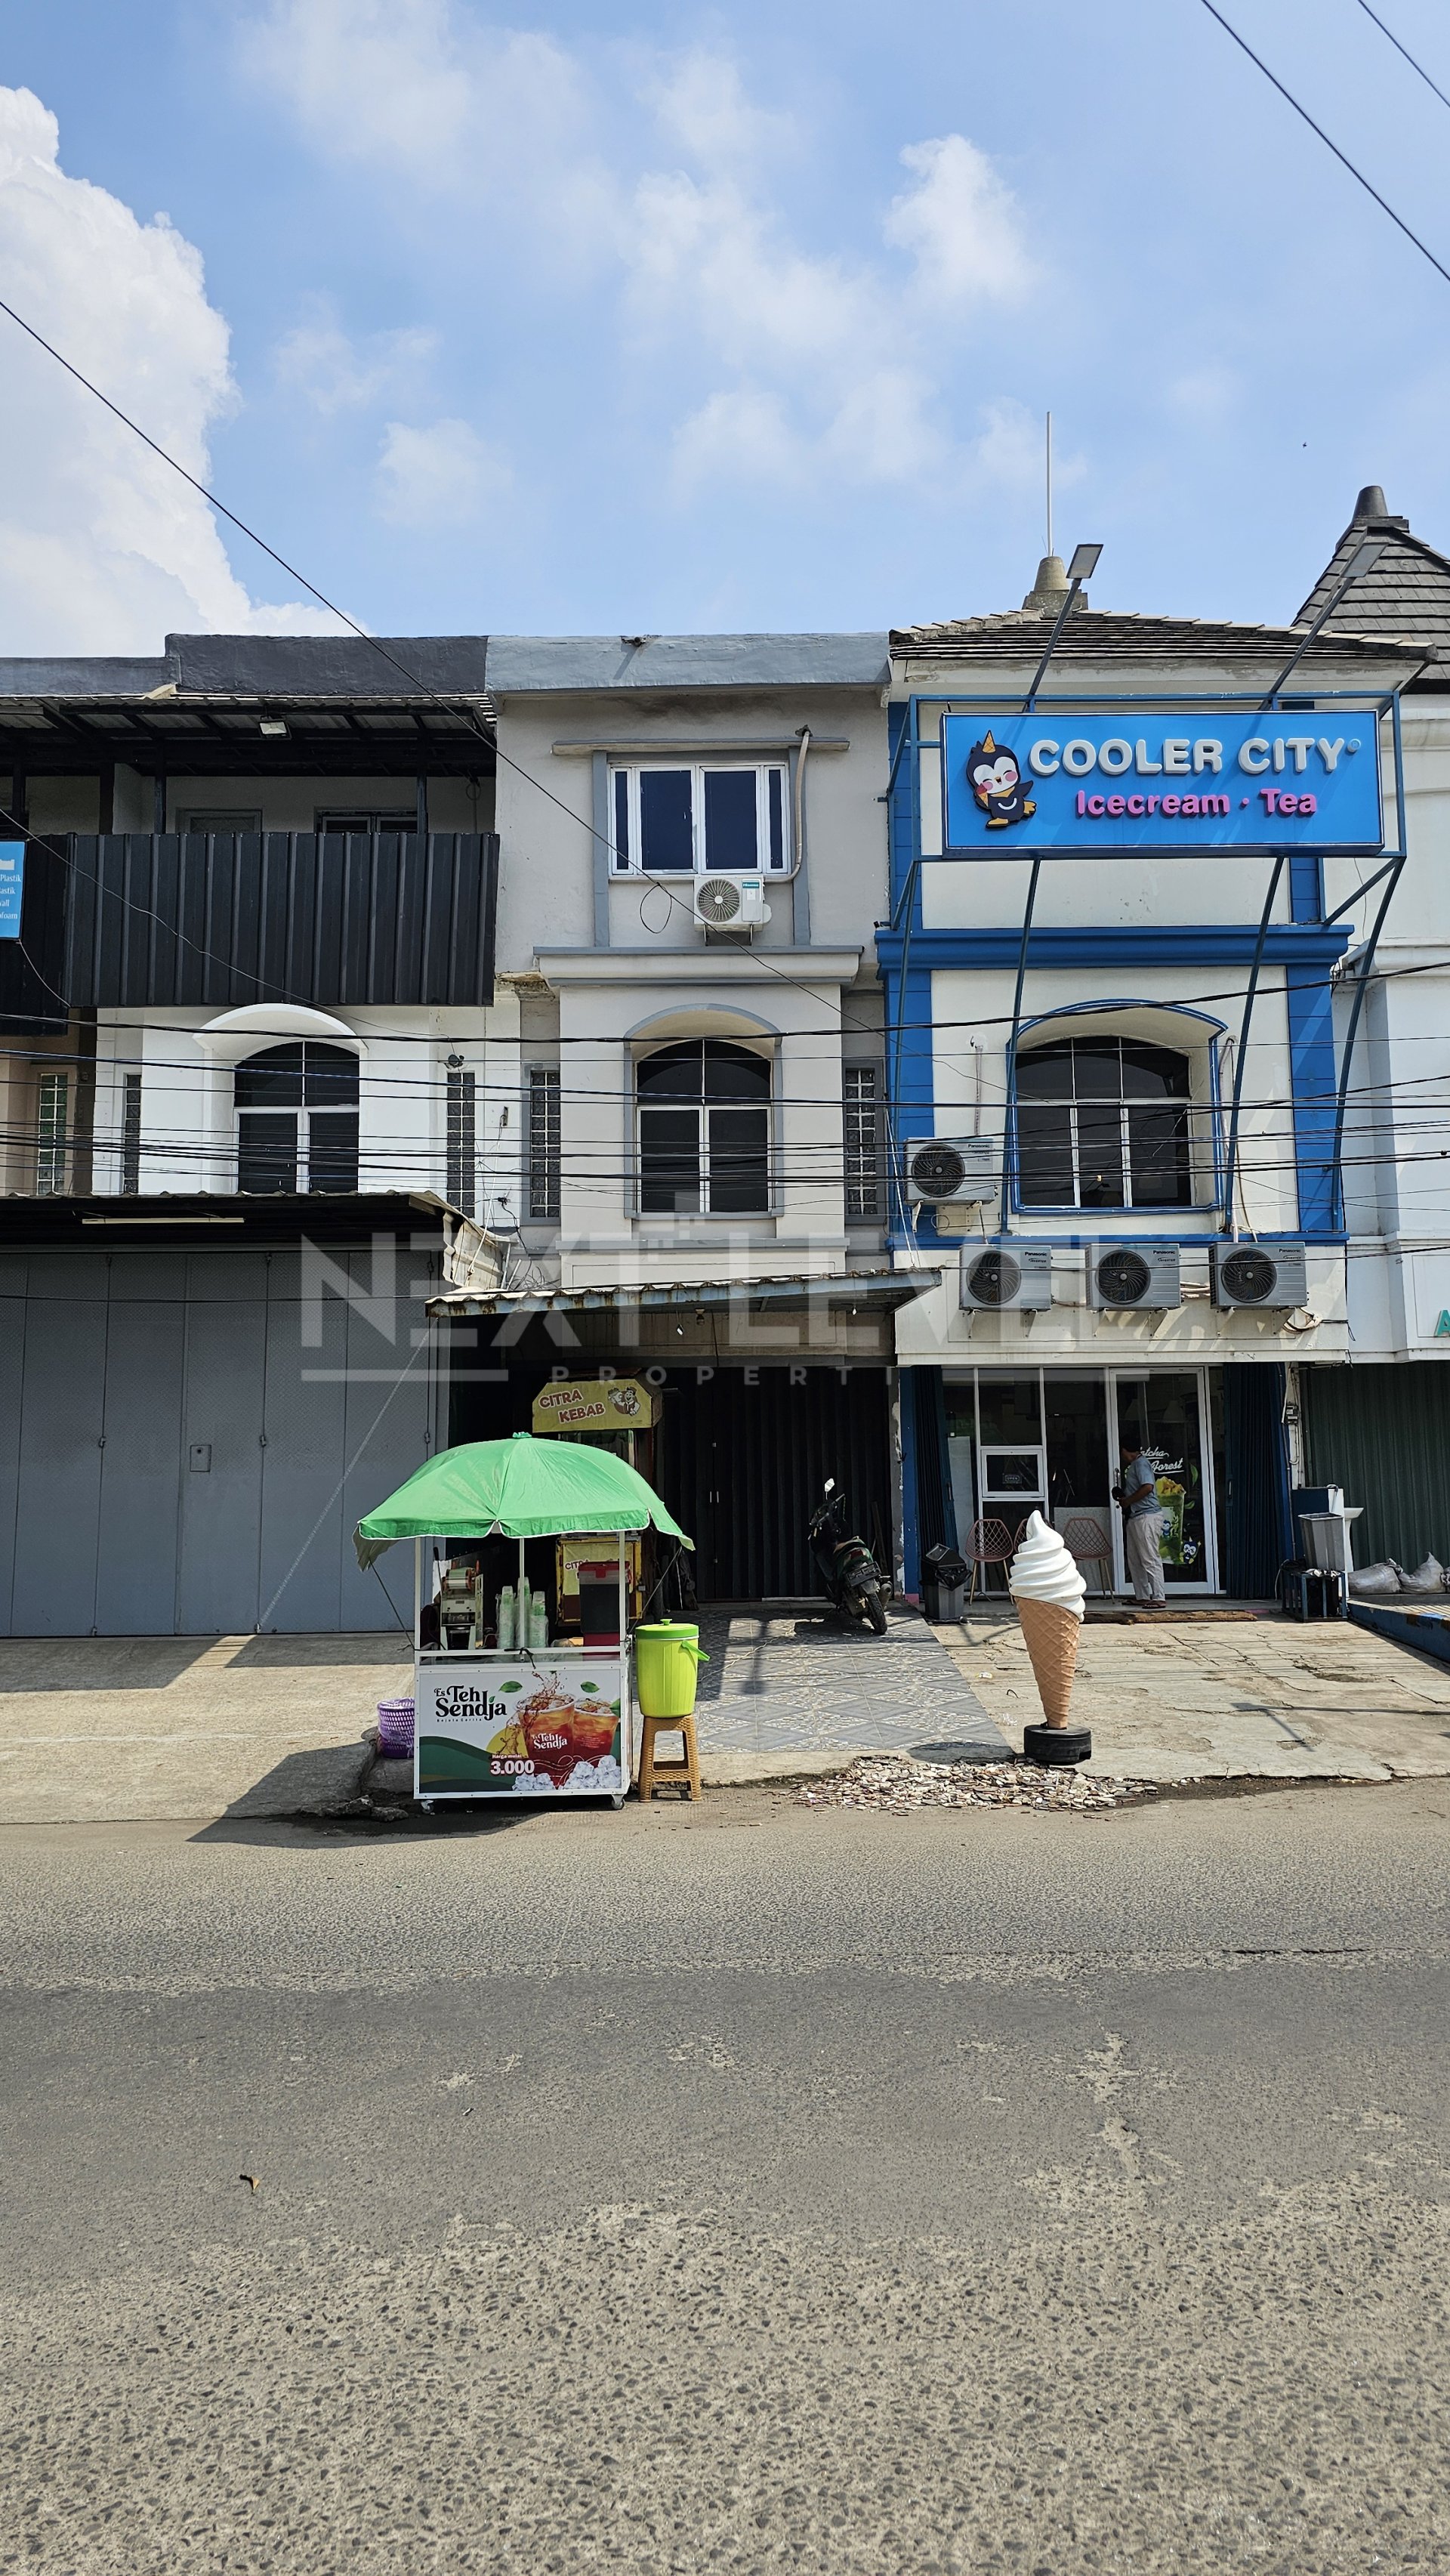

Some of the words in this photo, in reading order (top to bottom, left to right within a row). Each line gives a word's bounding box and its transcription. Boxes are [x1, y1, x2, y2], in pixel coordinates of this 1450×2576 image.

[1029, 739, 1223, 776] COOLER
[1238, 738, 1345, 773] CITY
[1076, 789, 1231, 817] Icecream
[1259, 788, 1317, 814] Tea
[539, 1388, 583, 1408] CITRA
[559, 1403, 605, 1422] KEBAB
[1139, 1446, 1170, 1457] atcha
[433, 1688, 446, 1697] Es
[446, 1685, 480, 1702] Teh
[435, 1691, 508, 1721] Sendja
[533, 1734, 568, 1750] Sendja
[538, 1733, 554, 1742] Teh
[490, 1759, 535, 1775] 3.000
